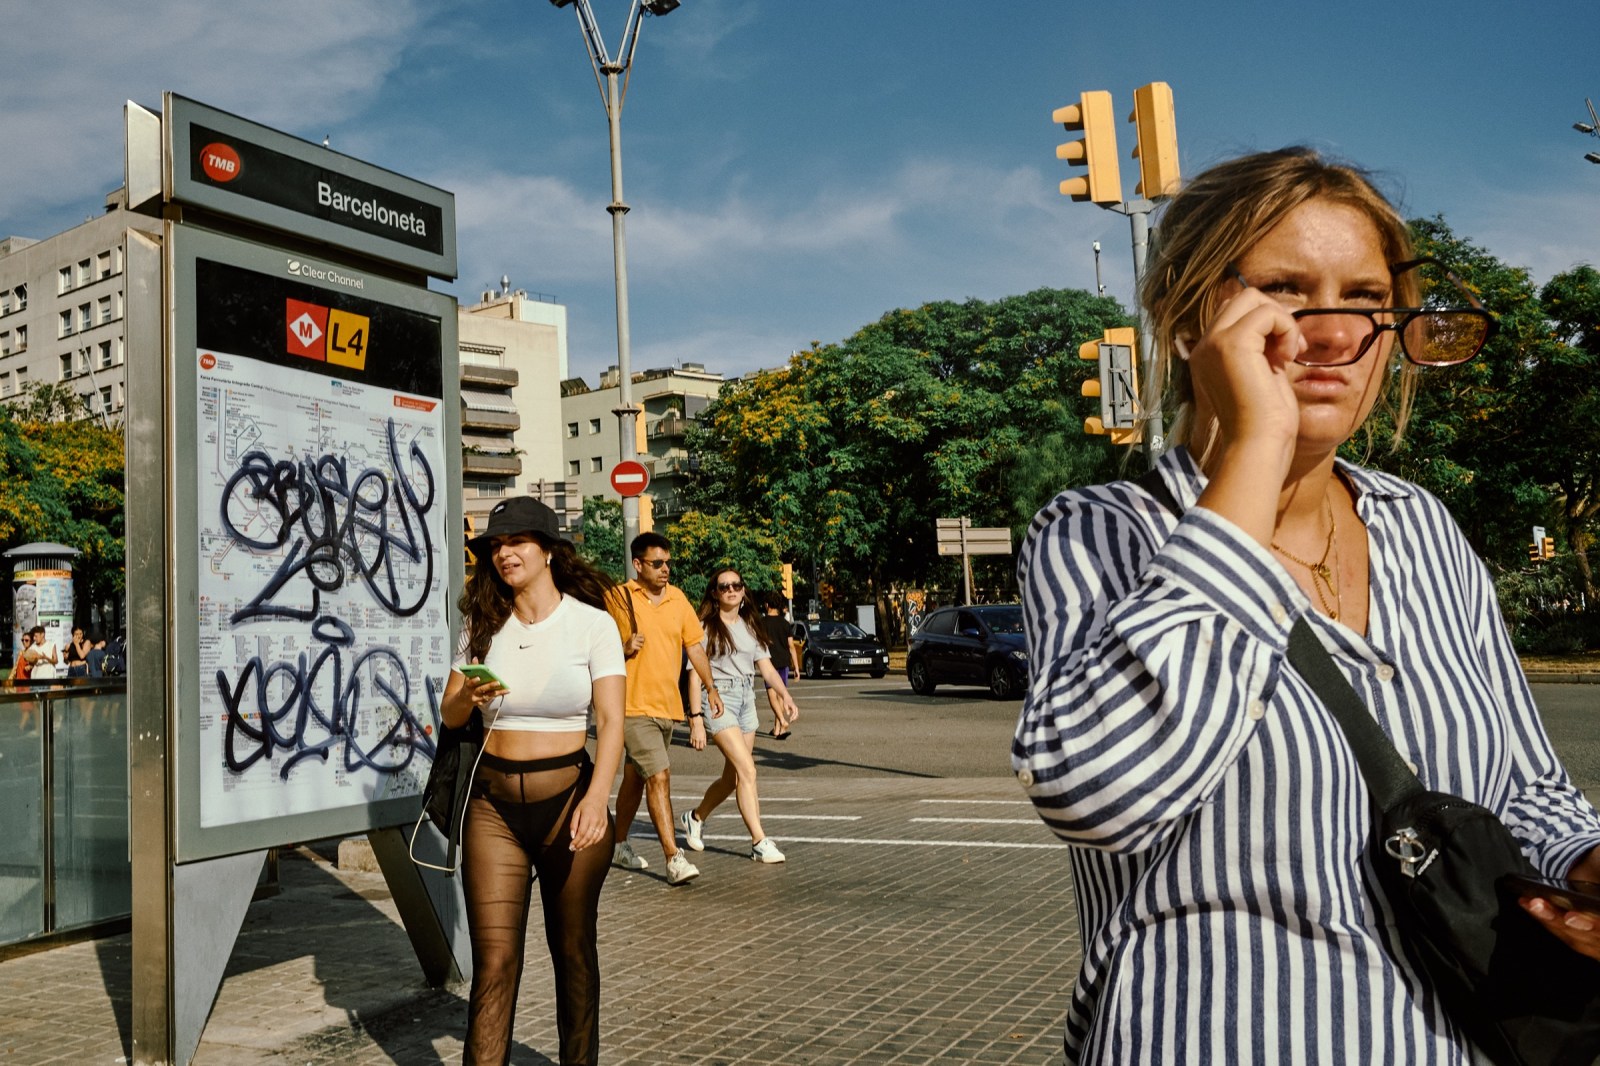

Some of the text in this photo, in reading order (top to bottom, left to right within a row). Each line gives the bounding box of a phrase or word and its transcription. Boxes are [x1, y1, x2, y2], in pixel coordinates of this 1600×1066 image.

[207, 153, 235, 173] TMB
[317, 181, 427, 237] Barceloneta
[301, 263, 365, 289] Clear Channel
[299, 322, 313, 340] M
[331, 323, 363, 356] L4
